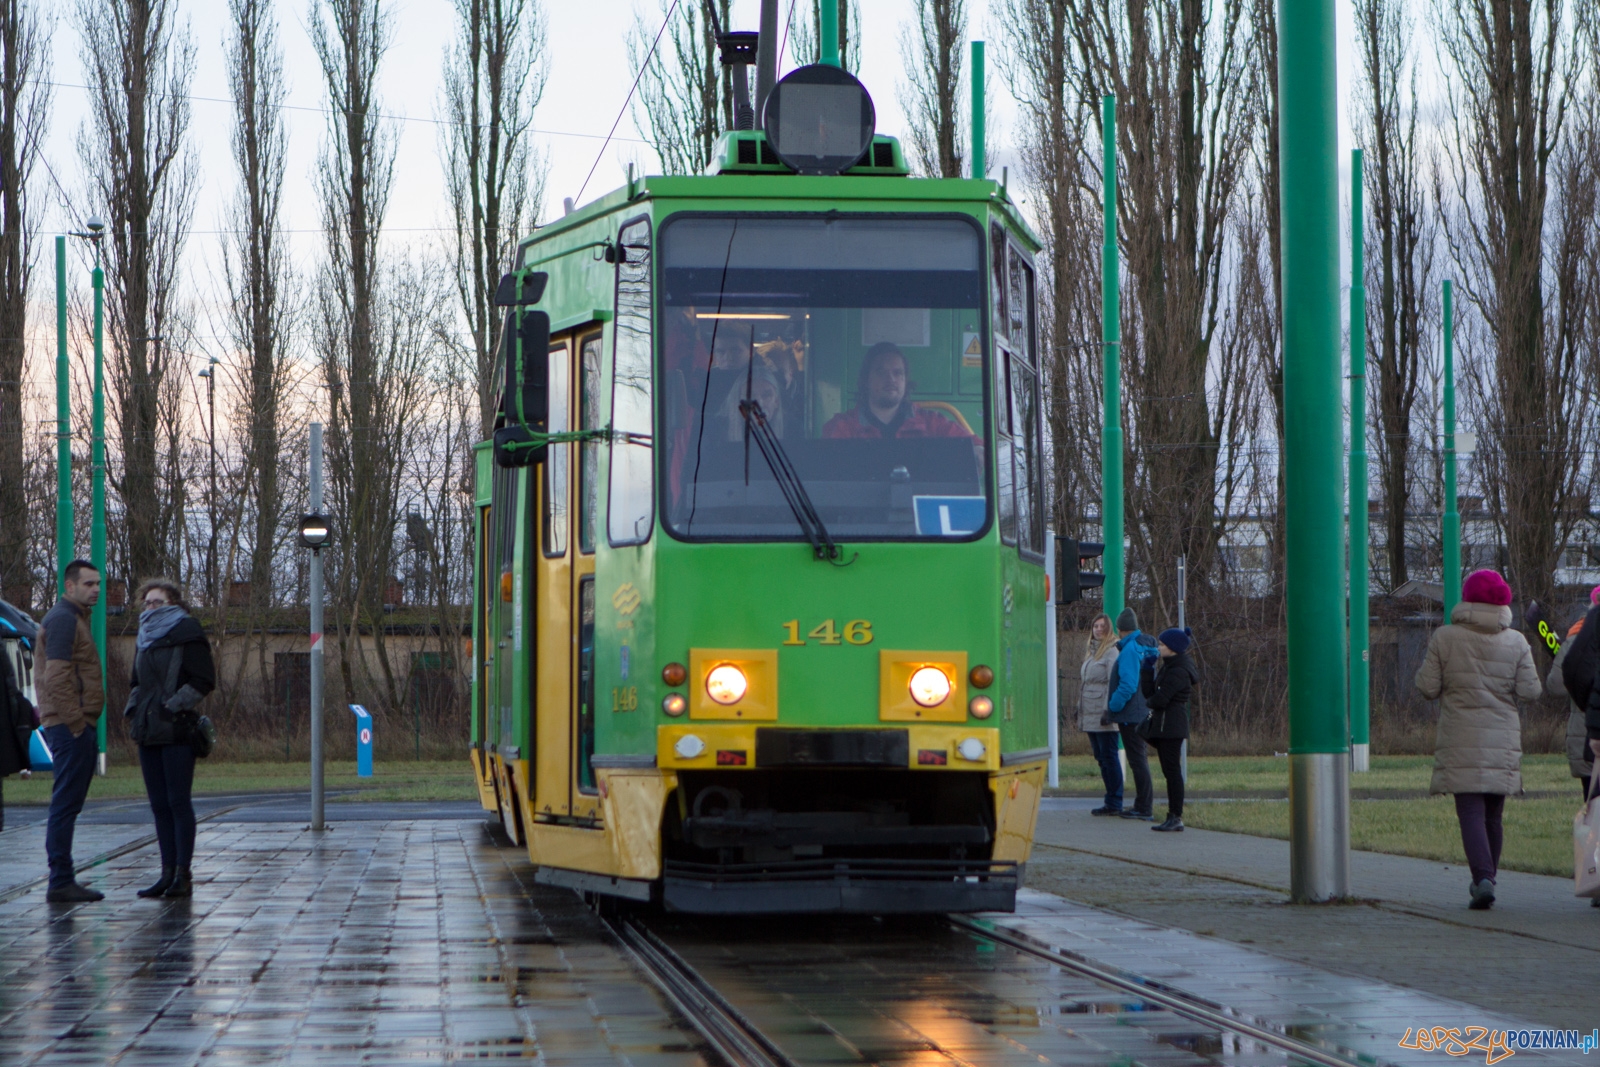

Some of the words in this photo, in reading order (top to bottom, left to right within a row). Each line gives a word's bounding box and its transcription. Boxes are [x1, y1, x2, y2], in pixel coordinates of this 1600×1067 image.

[939, 505, 974, 536] L
[782, 619, 874, 646] 146
[612, 686, 637, 712] 146
